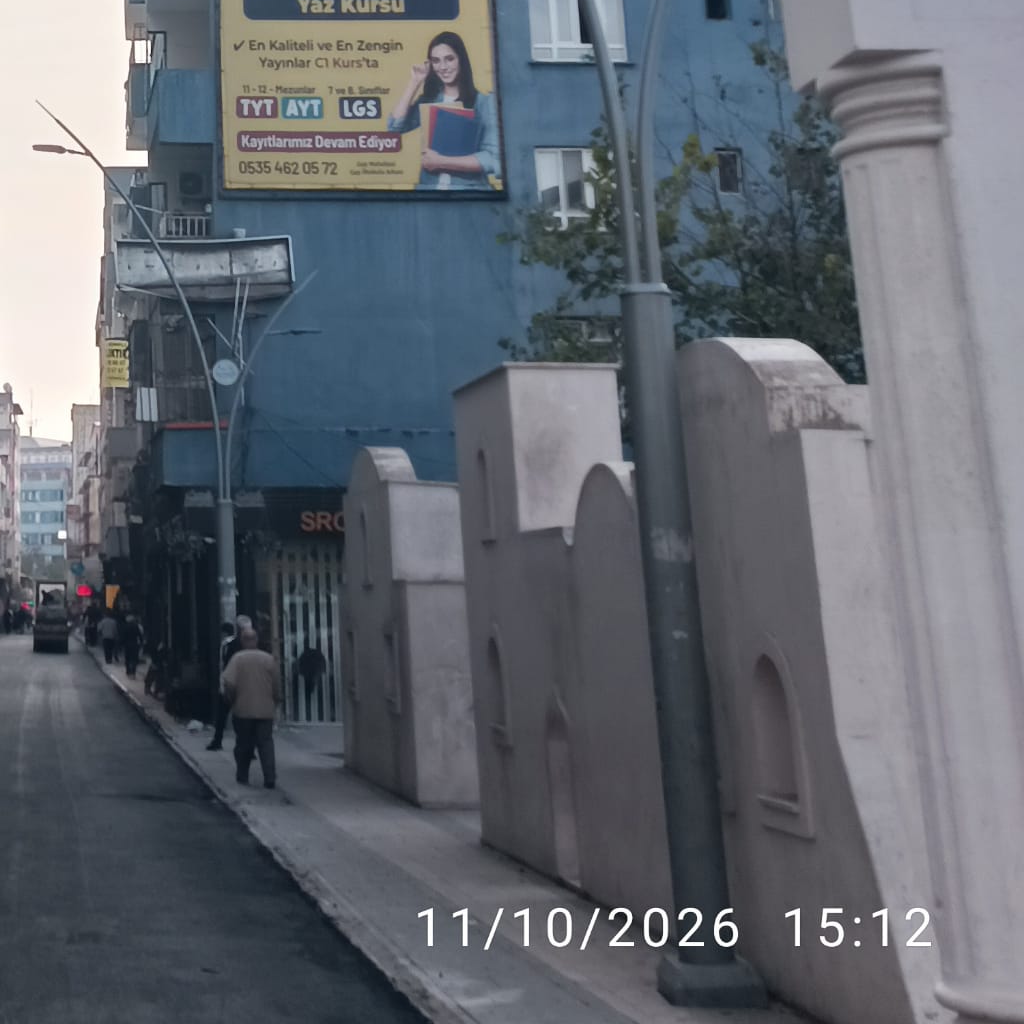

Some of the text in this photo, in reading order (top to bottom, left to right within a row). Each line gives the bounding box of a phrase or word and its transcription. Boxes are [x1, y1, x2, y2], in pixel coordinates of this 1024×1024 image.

[248, 39, 404, 54] En Kaliteli ve En Zengin
[258, 57, 311, 71] Yayınlar
[333, 57, 379, 68] Kurs'ta
[240, 99, 378, 118] TYT AYT LGS
[241, 135, 399, 151] Kayıtlarımız Devam Ediyor
[238, 160, 272, 175] 0535
[274, 161, 300, 176] 462
[302, 161, 319, 176] 05
[321, 161, 339, 176] 72
